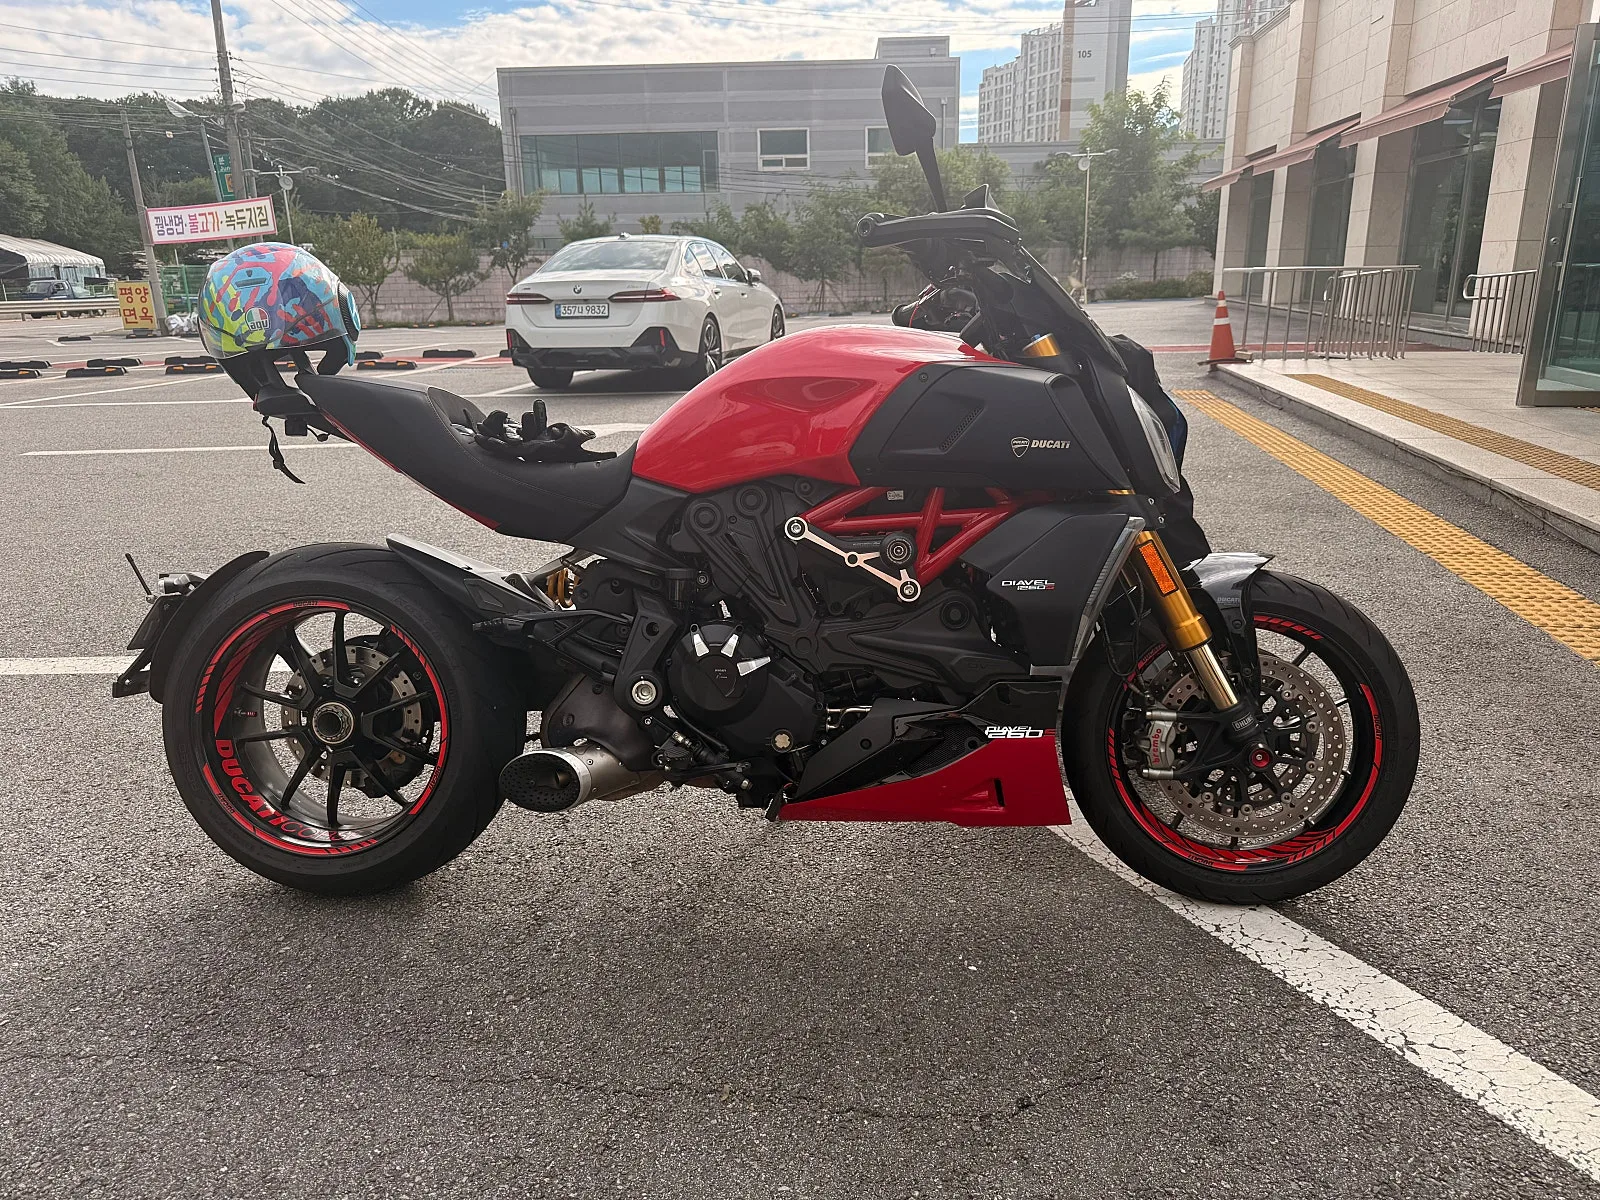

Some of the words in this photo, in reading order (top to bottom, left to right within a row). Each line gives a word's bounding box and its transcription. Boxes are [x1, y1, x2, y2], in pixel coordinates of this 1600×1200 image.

[1078, 50, 1092, 58] 105
[118, 286, 149, 304] 평양
[122, 306, 154, 324] 면옥
[586, 305, 607, 315] 9832
[1031, 440, 1071, 449] DUCATI
[1001, 579, 1055, 587] DIAVEL
[1152, 728, 1162, 764] brembo
[216, 739, 290, 826] DUCATI
